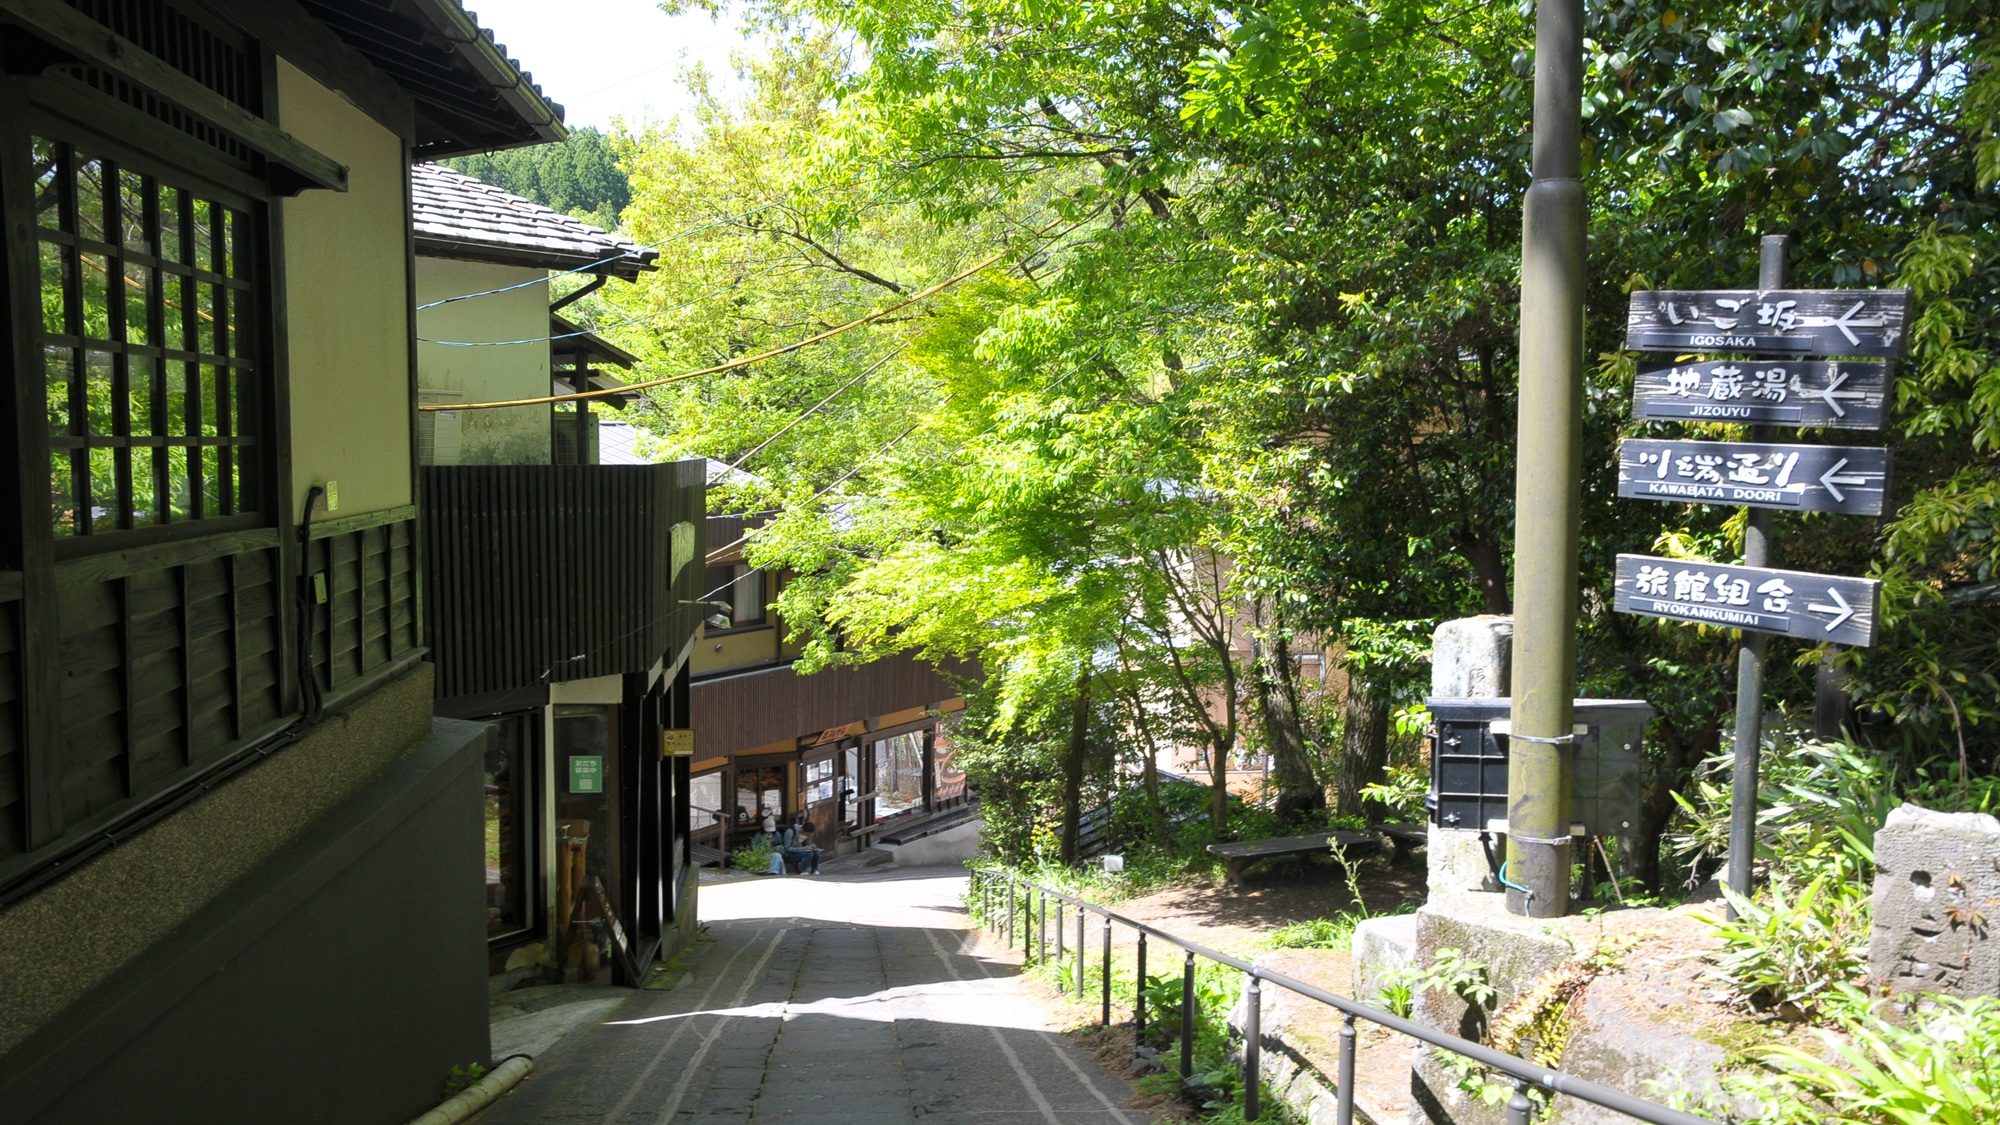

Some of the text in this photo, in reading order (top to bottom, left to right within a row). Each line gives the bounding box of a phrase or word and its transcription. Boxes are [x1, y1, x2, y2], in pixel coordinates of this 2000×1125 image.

[1666, 298, 1798, 332] いご坂
[1689, 335, 1757, 347] IGOSAKA
[1665, 365, 1788, 403] 地蔵湯
[1689, 405, 1751, 418] JIZOUYU
[1639, 449, 1800, 488] 川端通り
[1649, 483, 1781, 502] KAWABATA DOORI
[1635, 565, 1794, 614] 旅館組合
[1653, 601, 1759, 626] RYOKANKUMIAI
